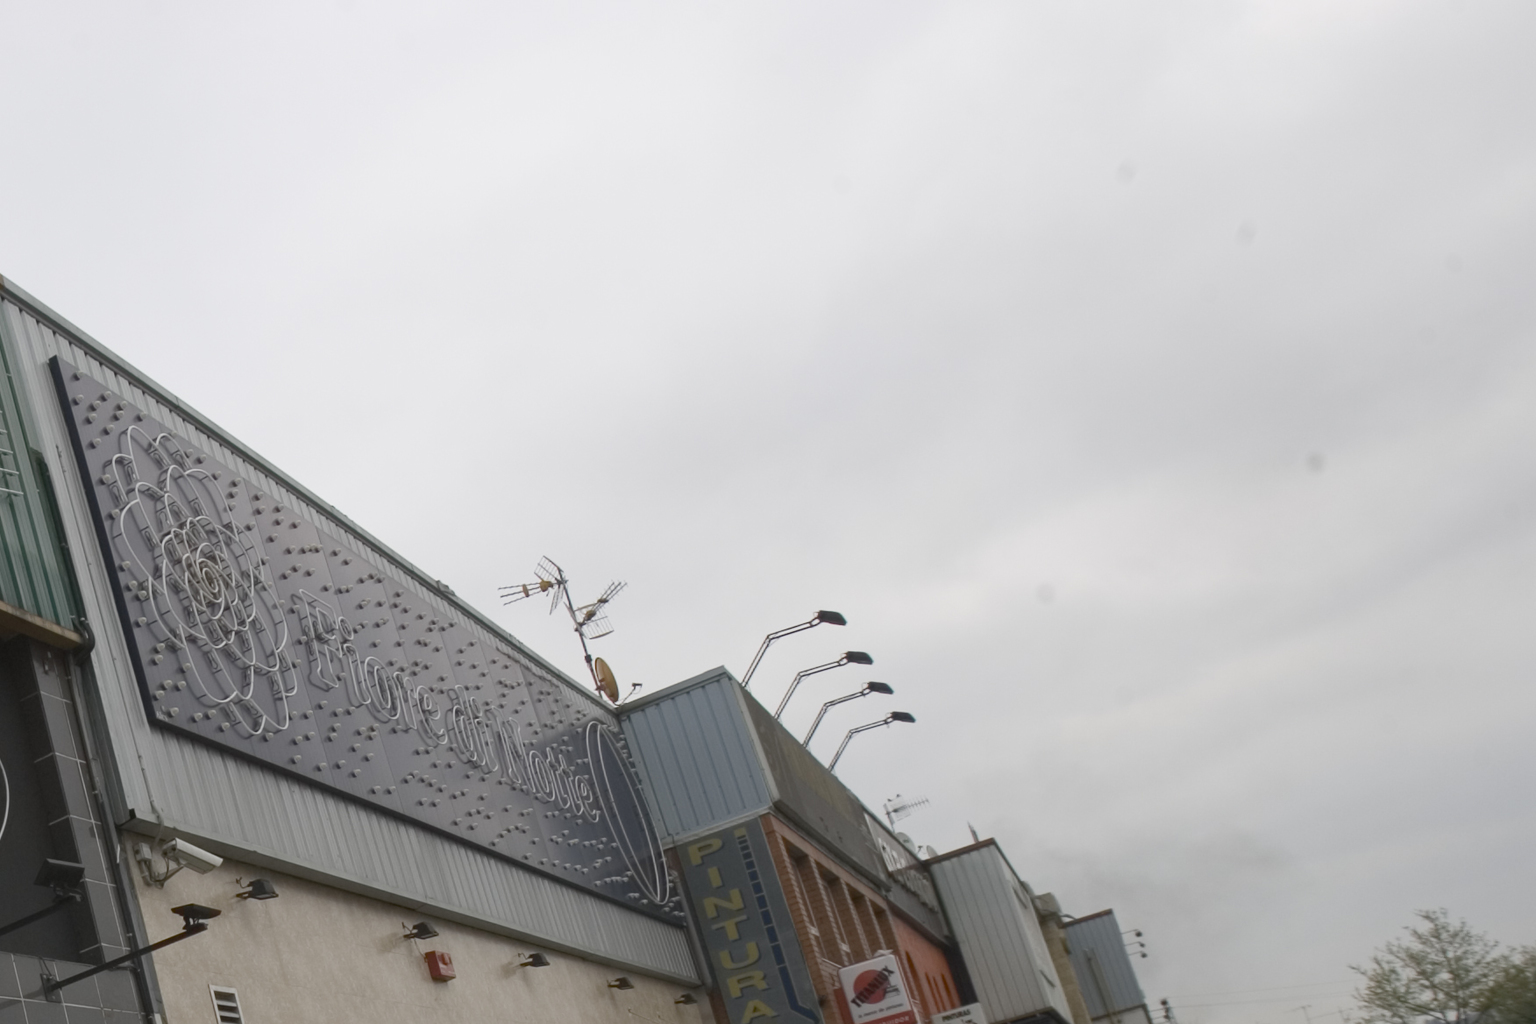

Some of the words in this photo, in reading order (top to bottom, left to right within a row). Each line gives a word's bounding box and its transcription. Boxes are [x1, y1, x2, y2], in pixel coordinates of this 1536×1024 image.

[296, 588, 447, 745] Fiore
[452, 684, 498, 773] di
[491, 705, 600, 823] Notte
